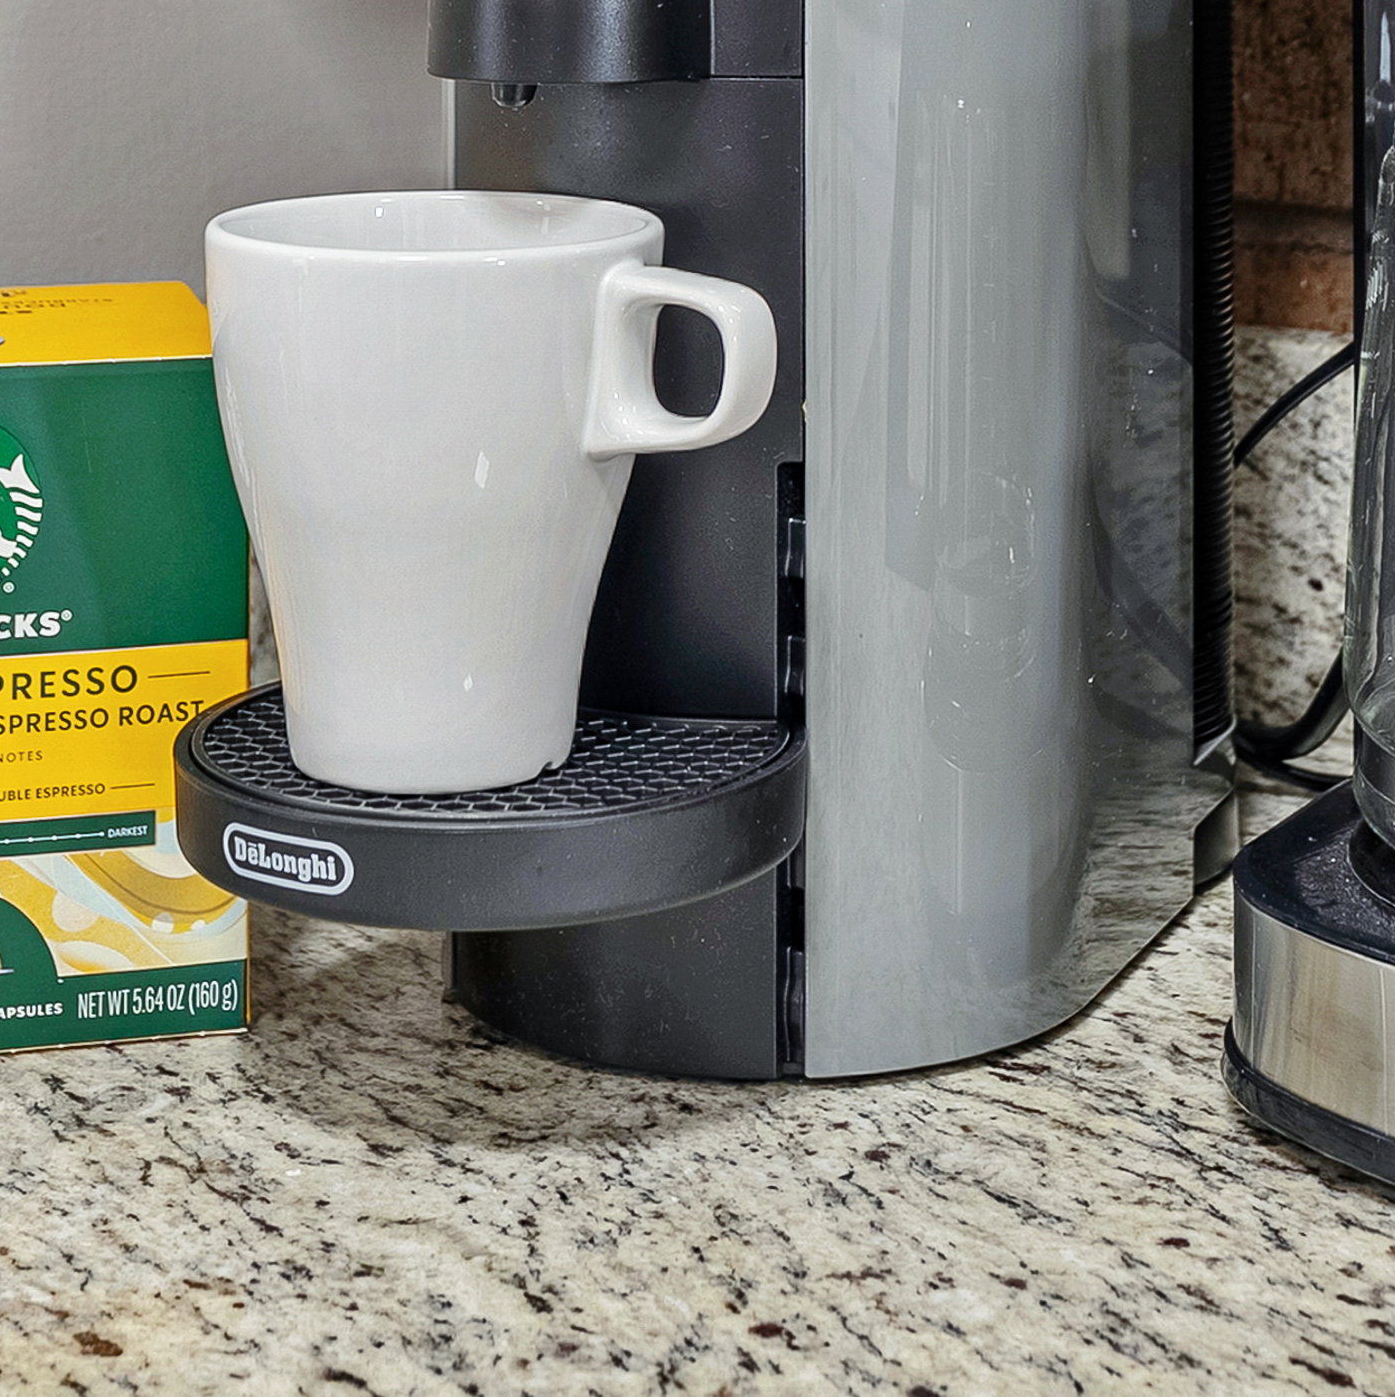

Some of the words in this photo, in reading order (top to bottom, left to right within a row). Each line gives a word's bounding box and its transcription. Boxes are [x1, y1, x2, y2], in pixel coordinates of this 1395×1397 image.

[119, 699, 205, 727] ROAST
[35, 782, 106, 800] ESPRESSO
[107, 825, 148, 839] DARKEST
[78, 992, 106, 1020] NET
[108, 990, 131, 1017] WT
[132, 987, 164, 1015] 5.64
[166, 983, 185, 1012] OZ
[188, 980, 218, 1014] (160
[221, 977, 239, 1011] g)
